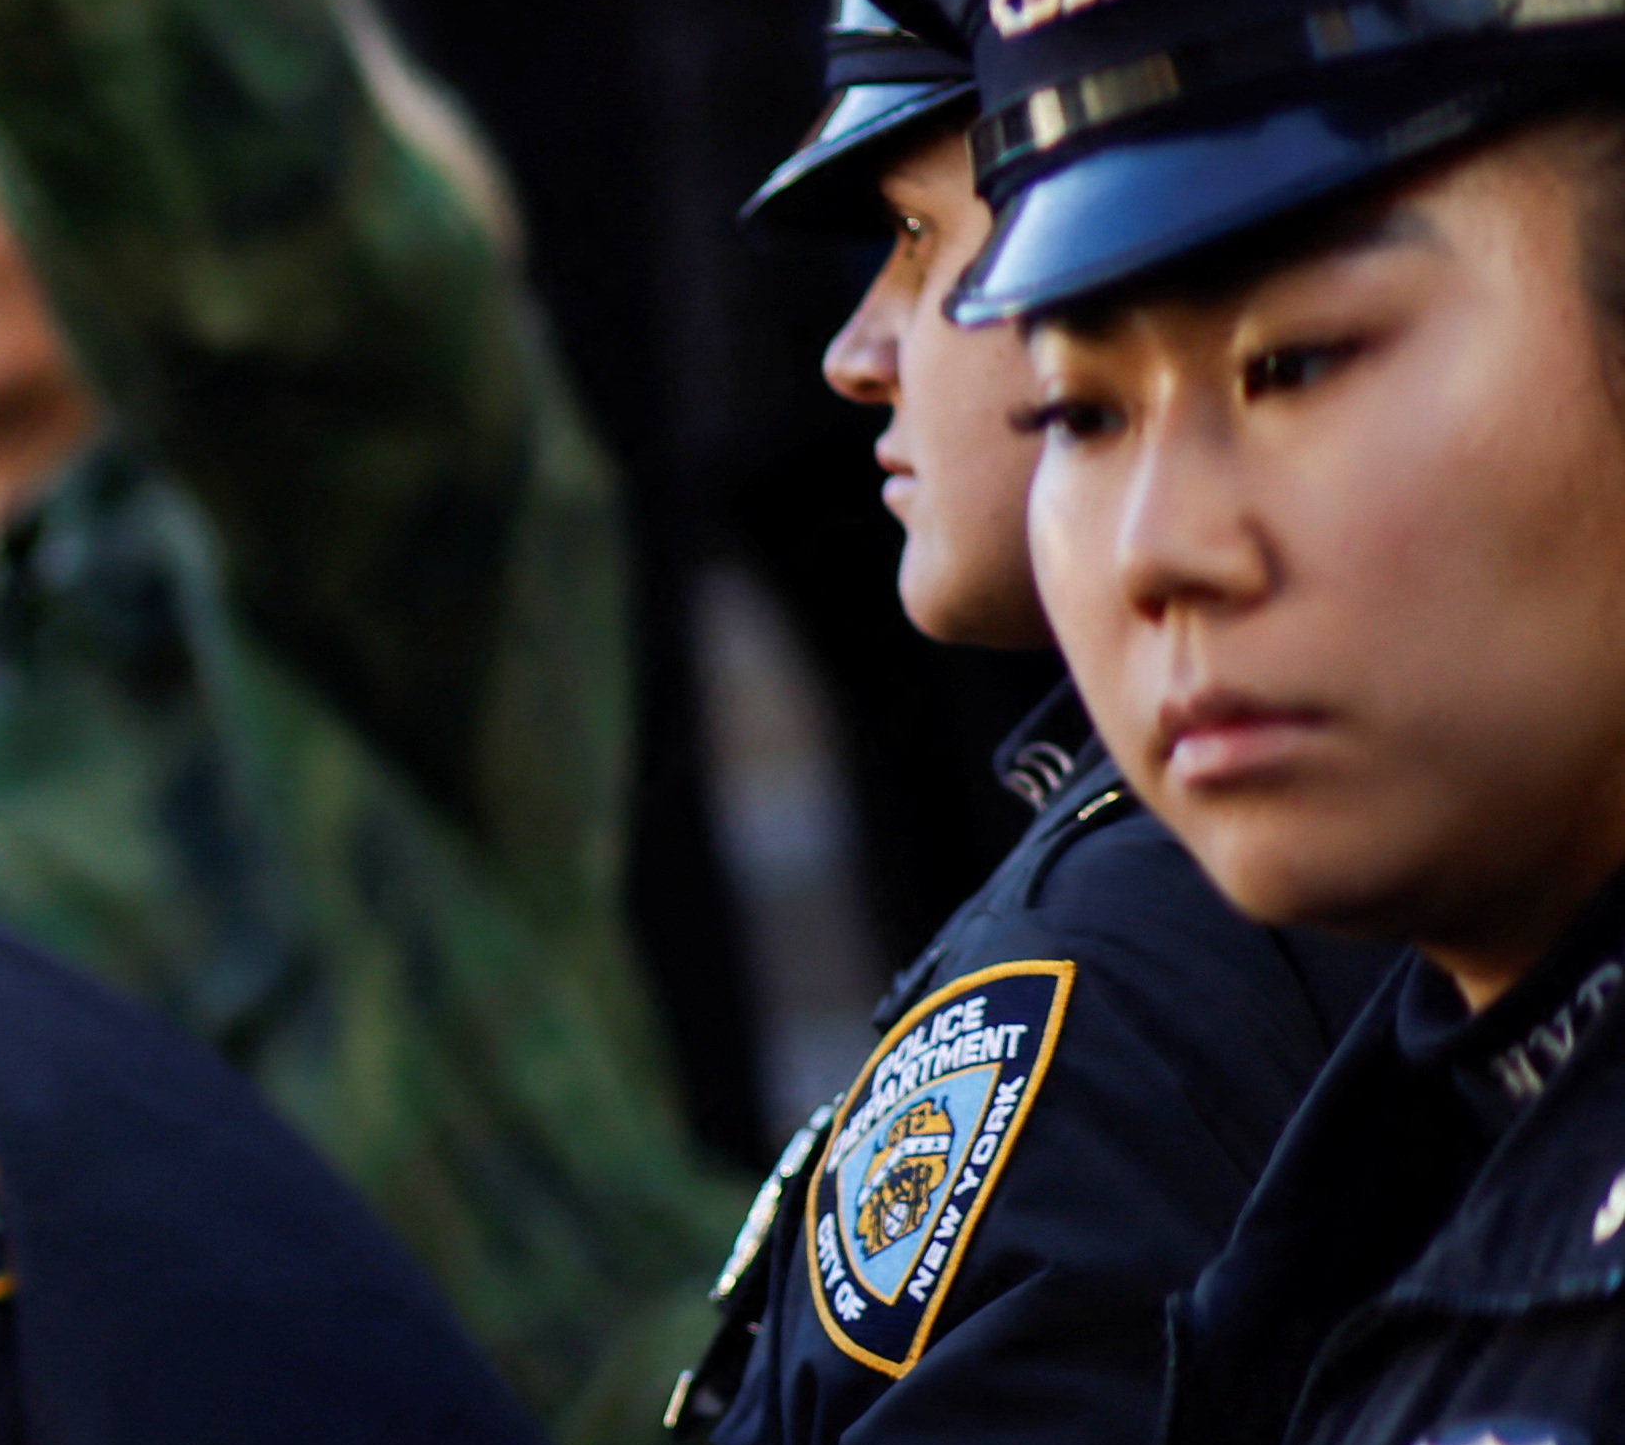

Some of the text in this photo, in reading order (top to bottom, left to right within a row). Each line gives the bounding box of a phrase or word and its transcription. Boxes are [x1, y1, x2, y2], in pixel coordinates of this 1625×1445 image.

[826, 1023, 1029, 1173] DEPARTMENT
[872, 996, 988, 1095] POLICE
[907, 1075, 1026, 1303] NEW YORK
[834, 1281, 868, 1322] OF
